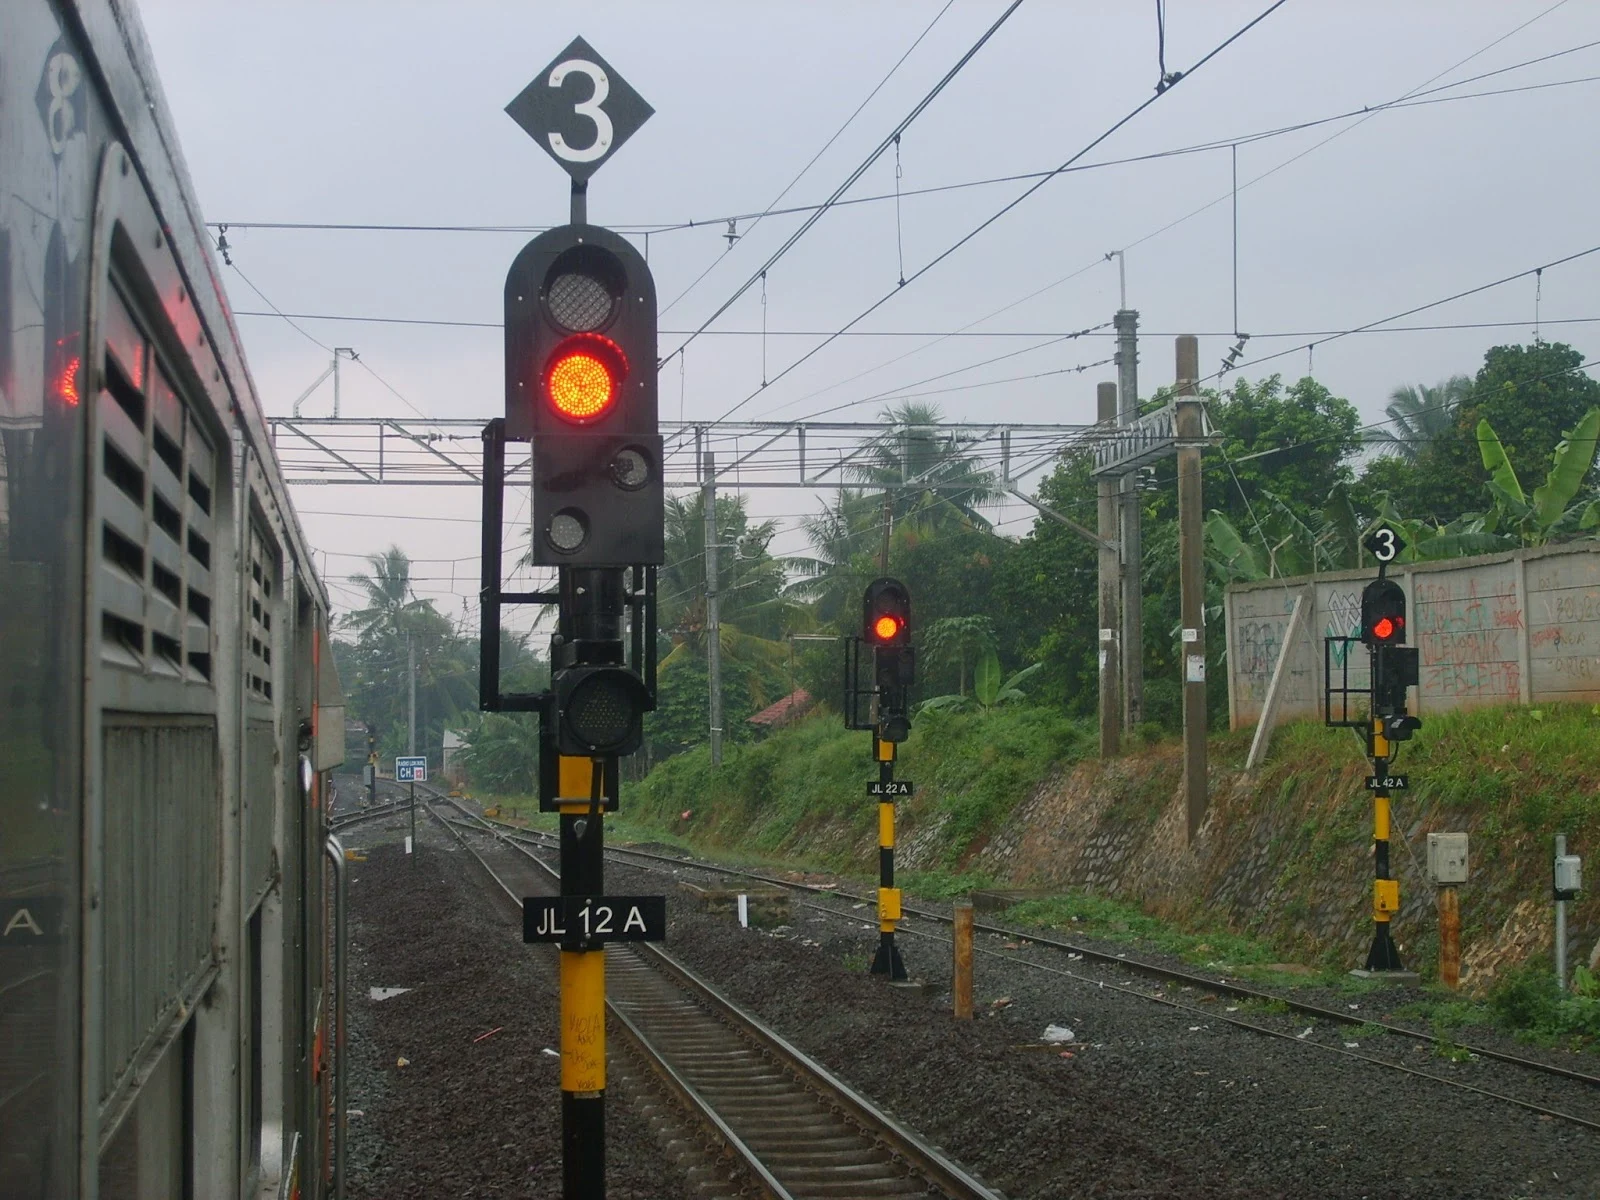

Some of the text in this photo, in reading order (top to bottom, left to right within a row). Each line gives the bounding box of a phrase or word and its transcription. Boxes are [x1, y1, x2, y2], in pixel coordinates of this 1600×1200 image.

[548, 58, 614, 163] 3
[1375, 528, 1396, 561] 3
[871, 783, 908, 794] JL 22 A
[1370, 778, 1404, 788] JL 42 A
[536, 905, 648, 935] JL 12 A
